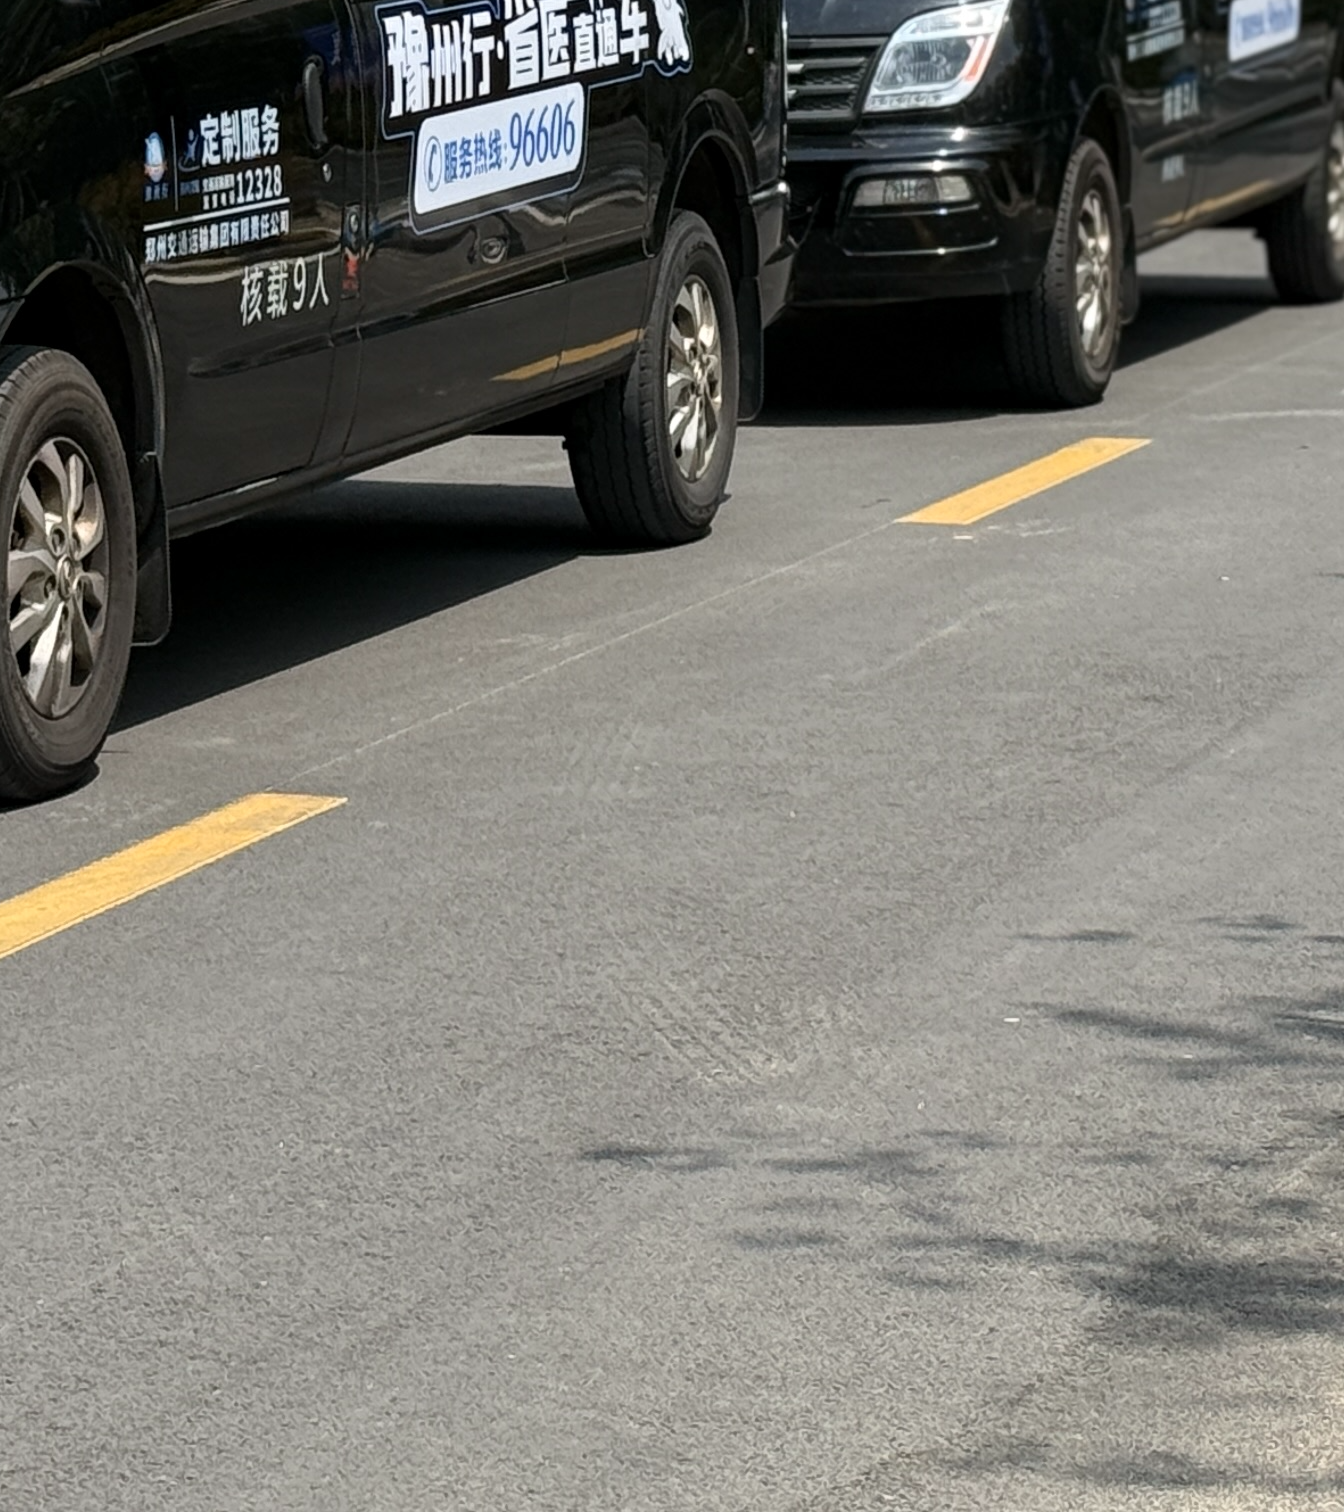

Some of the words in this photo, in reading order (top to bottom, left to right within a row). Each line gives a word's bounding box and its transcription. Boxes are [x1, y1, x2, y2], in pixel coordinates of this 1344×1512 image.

[200, 104, 280, 167] 定制服务
[236, 164, 283, 204] 12328
[240, 252, 329, 327] 核载9人
